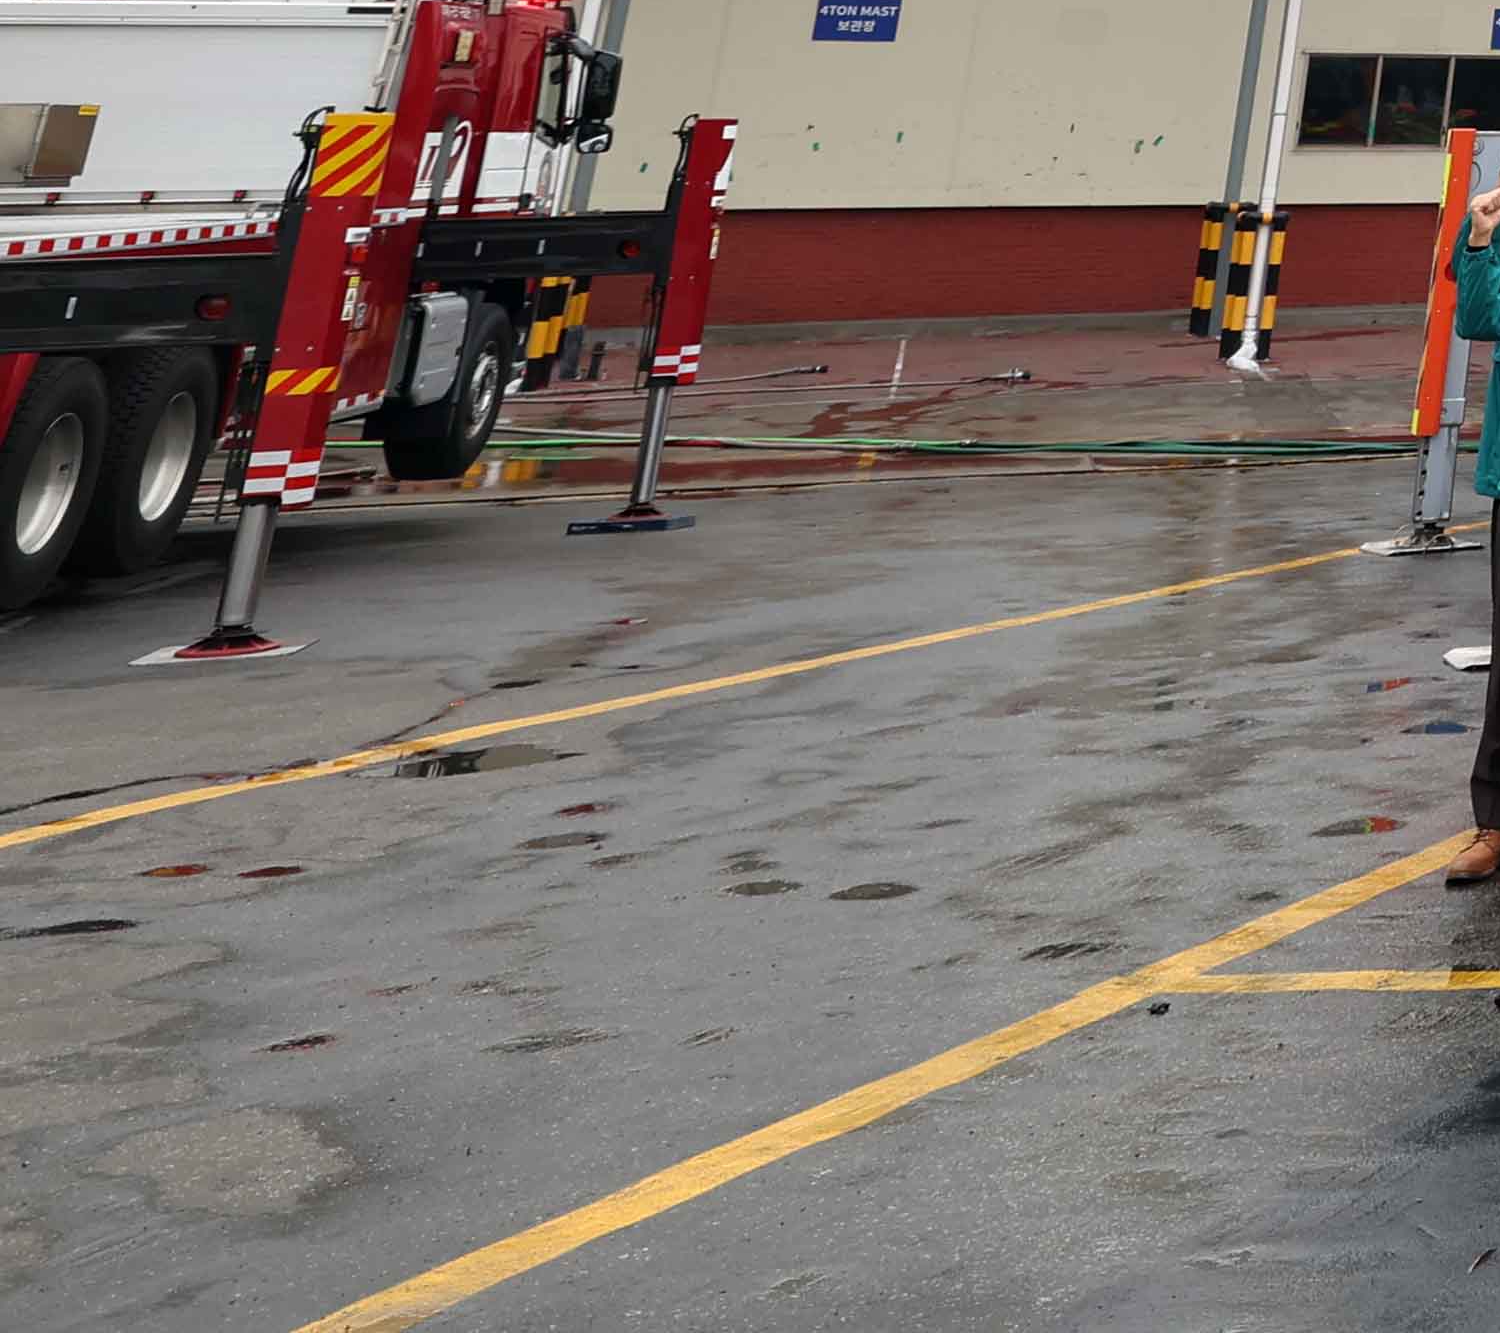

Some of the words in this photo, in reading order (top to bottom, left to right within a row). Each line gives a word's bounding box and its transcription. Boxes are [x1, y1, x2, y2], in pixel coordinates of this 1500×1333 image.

[820, 5, 857, 17] 4TON
[860, 5, 899, 17] MAST
[837, 20, 876, 33] 보관장
